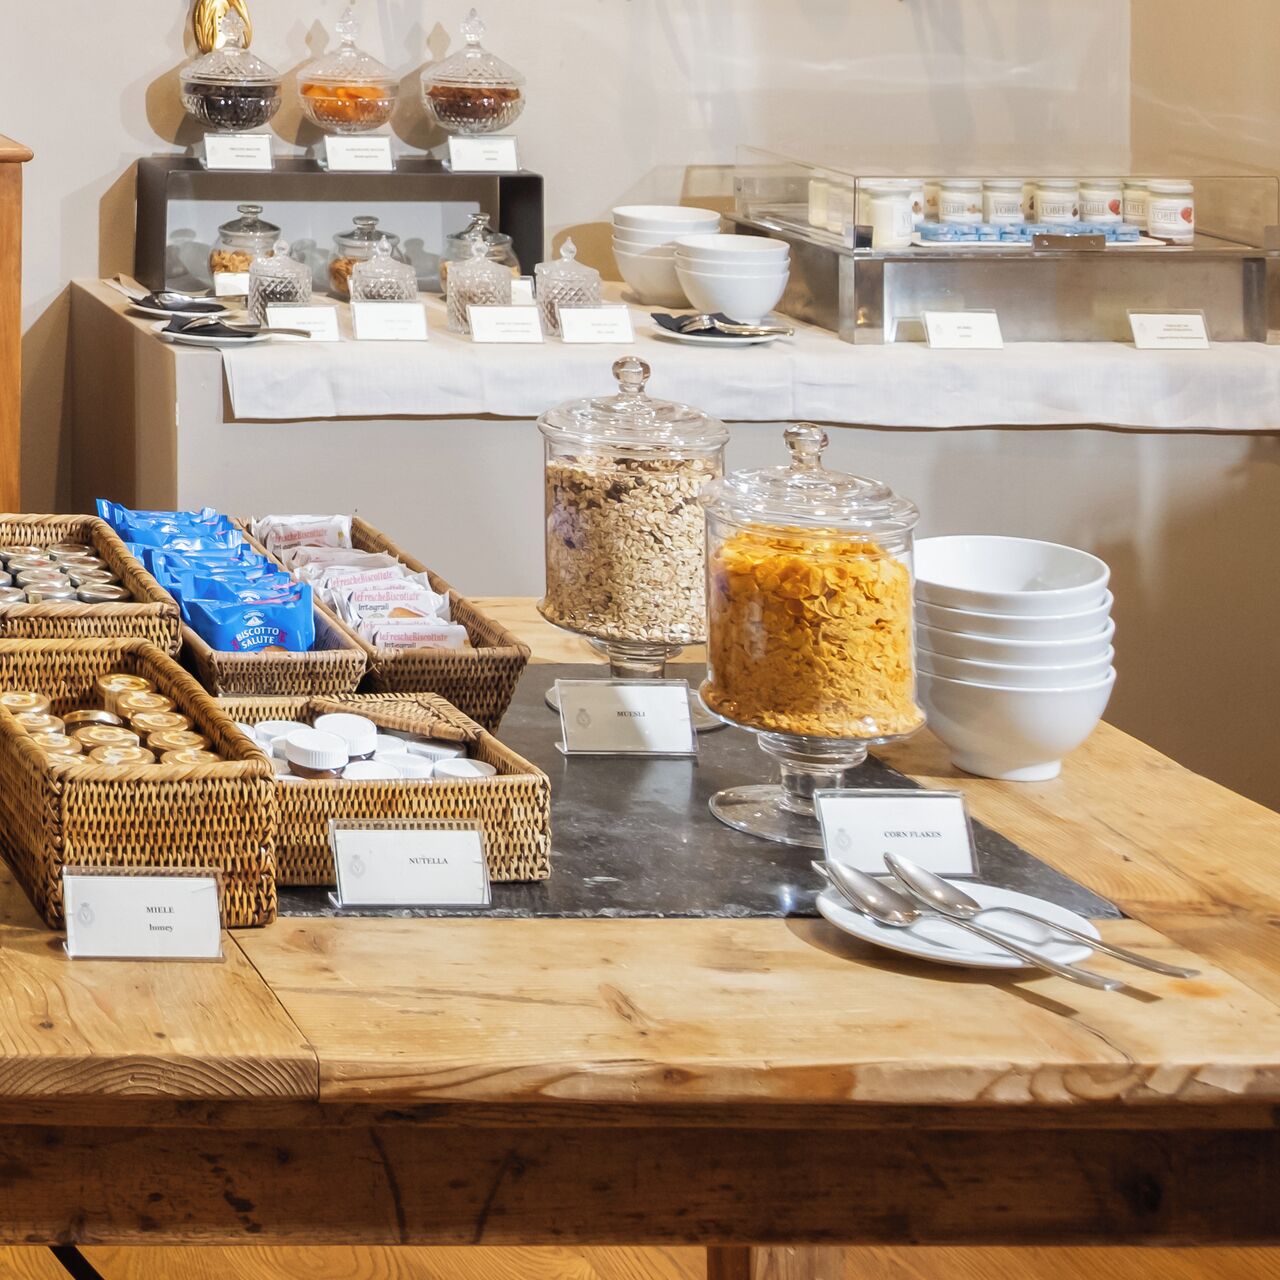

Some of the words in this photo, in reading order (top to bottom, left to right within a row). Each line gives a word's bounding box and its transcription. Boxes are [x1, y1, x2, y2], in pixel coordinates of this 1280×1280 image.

[236, 626, 280, 641] BISCOTTO
[241, 635, 275, 649] SALUTE
[149, 923, 174, 932] honey
